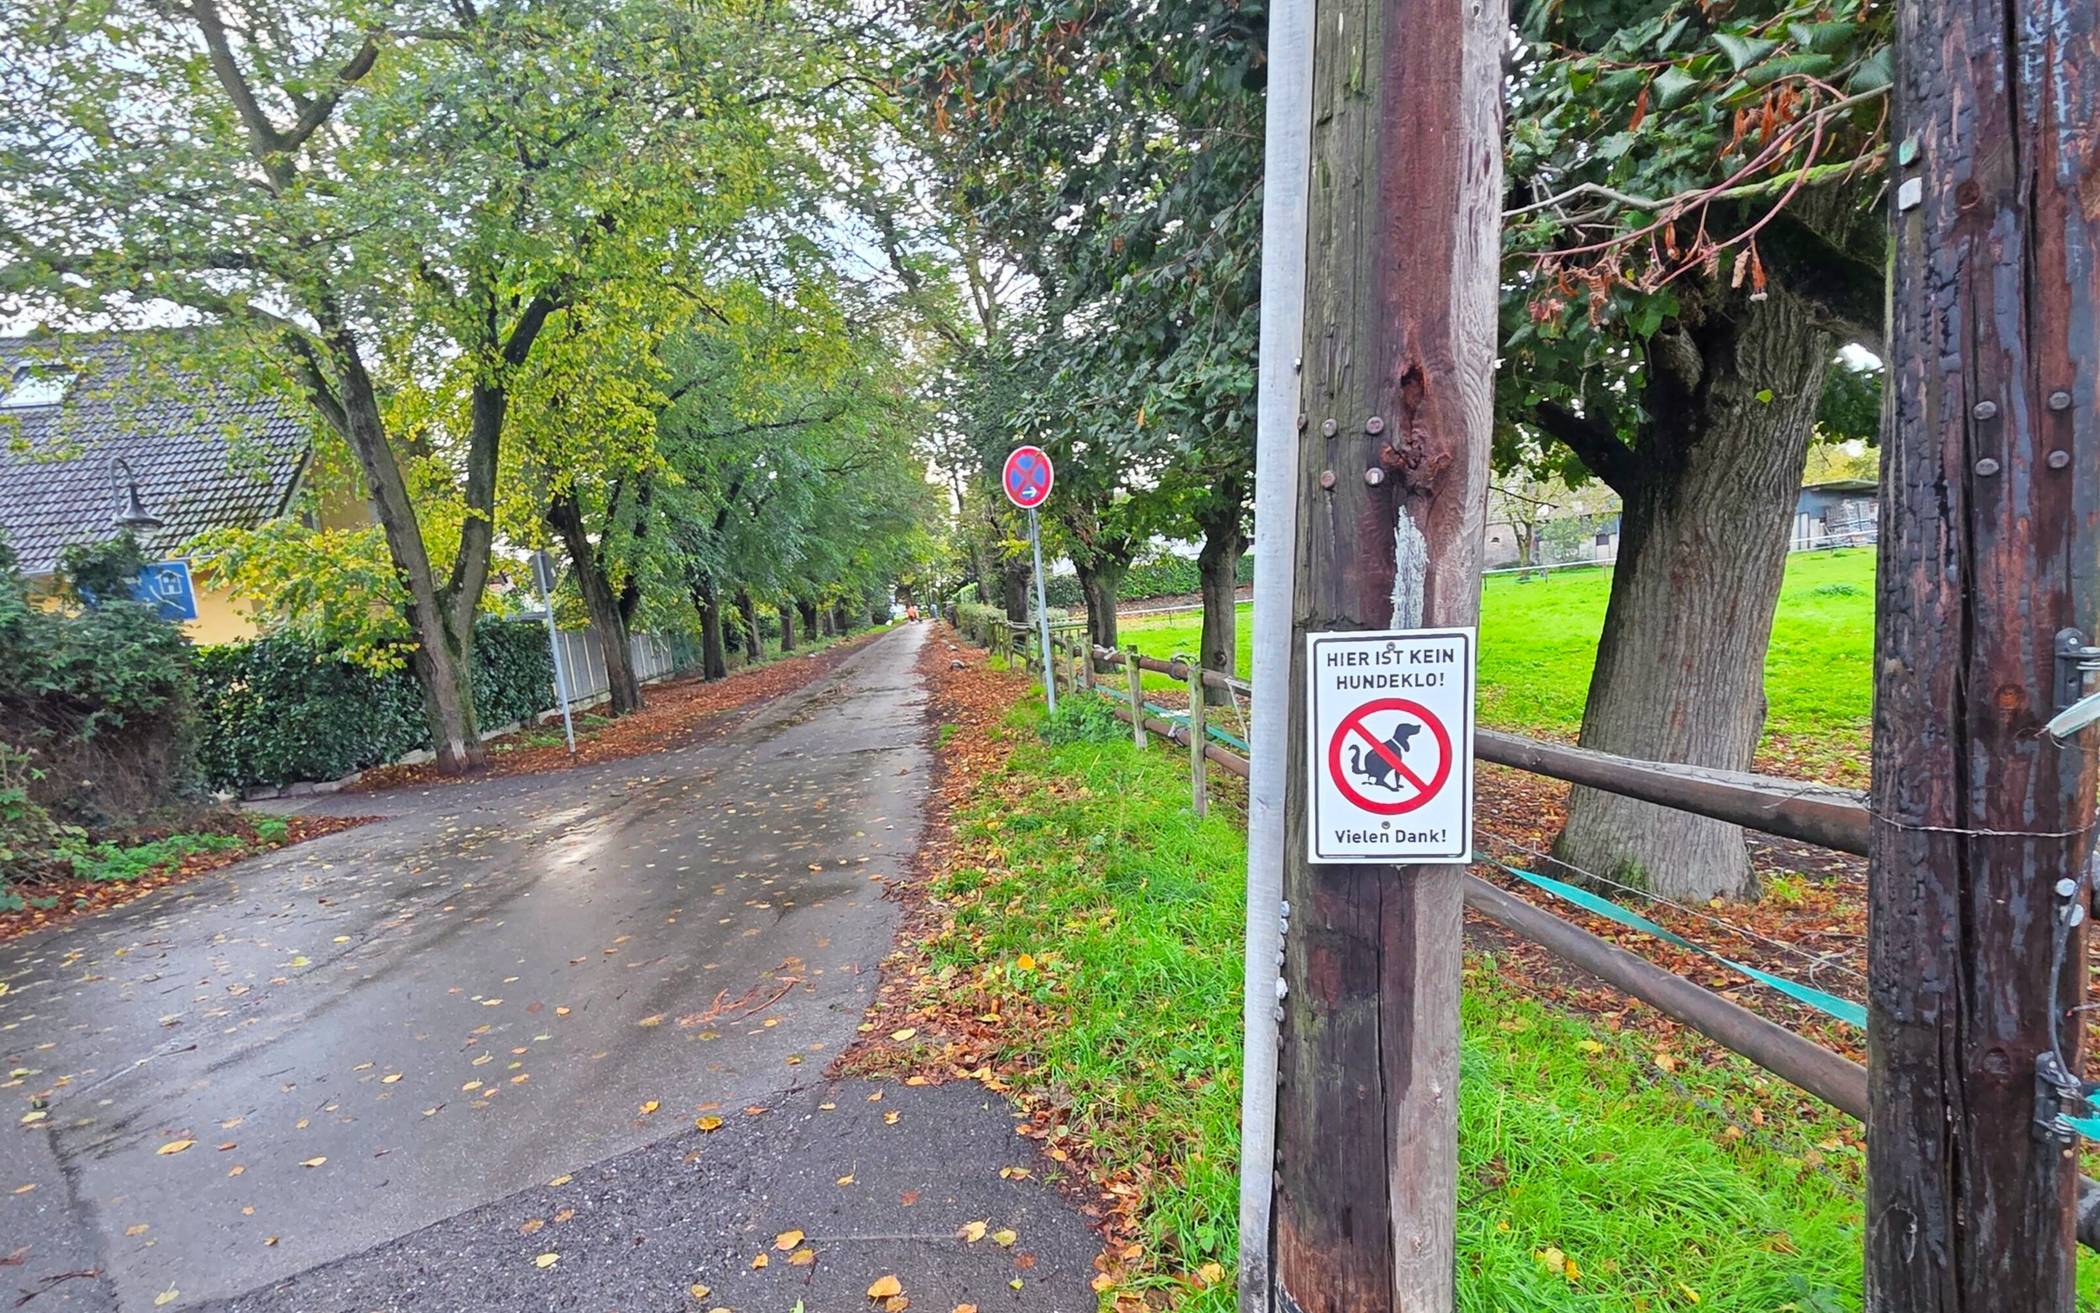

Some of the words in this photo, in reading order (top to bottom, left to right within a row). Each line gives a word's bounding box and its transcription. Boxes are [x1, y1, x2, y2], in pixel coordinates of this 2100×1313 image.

[1327, 652, 1370, 667] HIER
[1376, 650, 1404, 665] IST
[1410, 648, 1454, 664] KEIN
[1336, 672, 1444, 690] HUNDEKLO!
[1335, 829, 1389, 843] Vielen
[1395, 829, 1446, 843] Dank!
